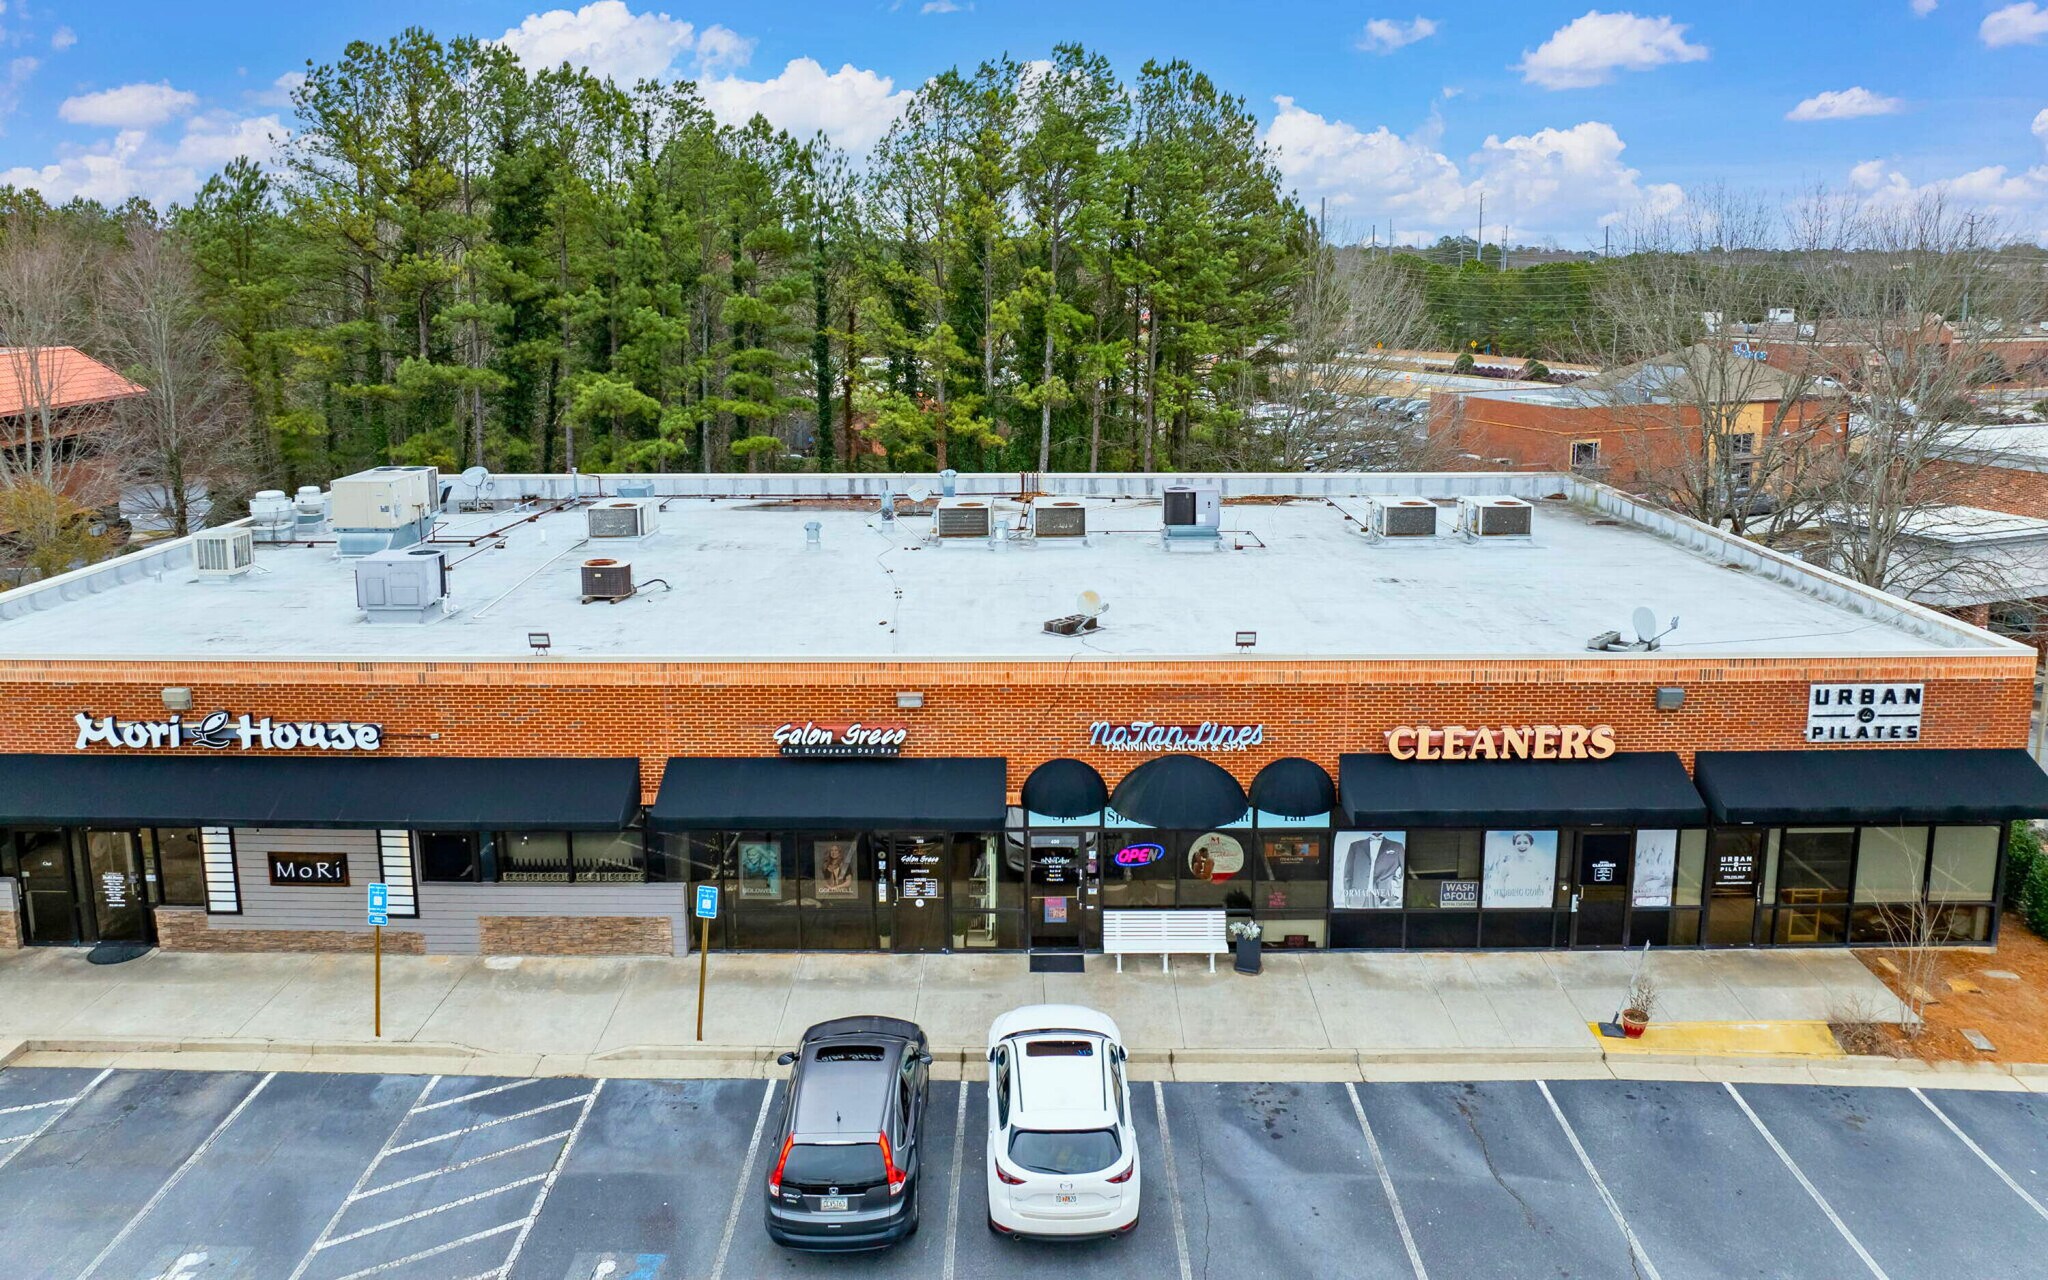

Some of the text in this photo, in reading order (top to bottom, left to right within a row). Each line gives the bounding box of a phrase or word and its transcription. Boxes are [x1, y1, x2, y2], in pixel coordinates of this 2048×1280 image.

[1815, 688, 1921, 705] URBAN
[74, 711, 381, 751] Mori House
[773, 720, 907, 746] Salon Greco
[1188, 721, 1264, 747] Lines
[1811, 726, 1918, 740] PILATES
[1105, 741, 1248, 752] TANNING SALON & SPA
[1387, 724, 1617, 761] CLEANERS
[804, 747, 852, 755] European
[857, 747, 875, 755] Day
[880, 747, 898, 755] Spa
[1117, 848, 1158, 863] OPEN
[1446, 883, 1475, 892] WASH
[1450, 892, 1476, 901] FOLD
